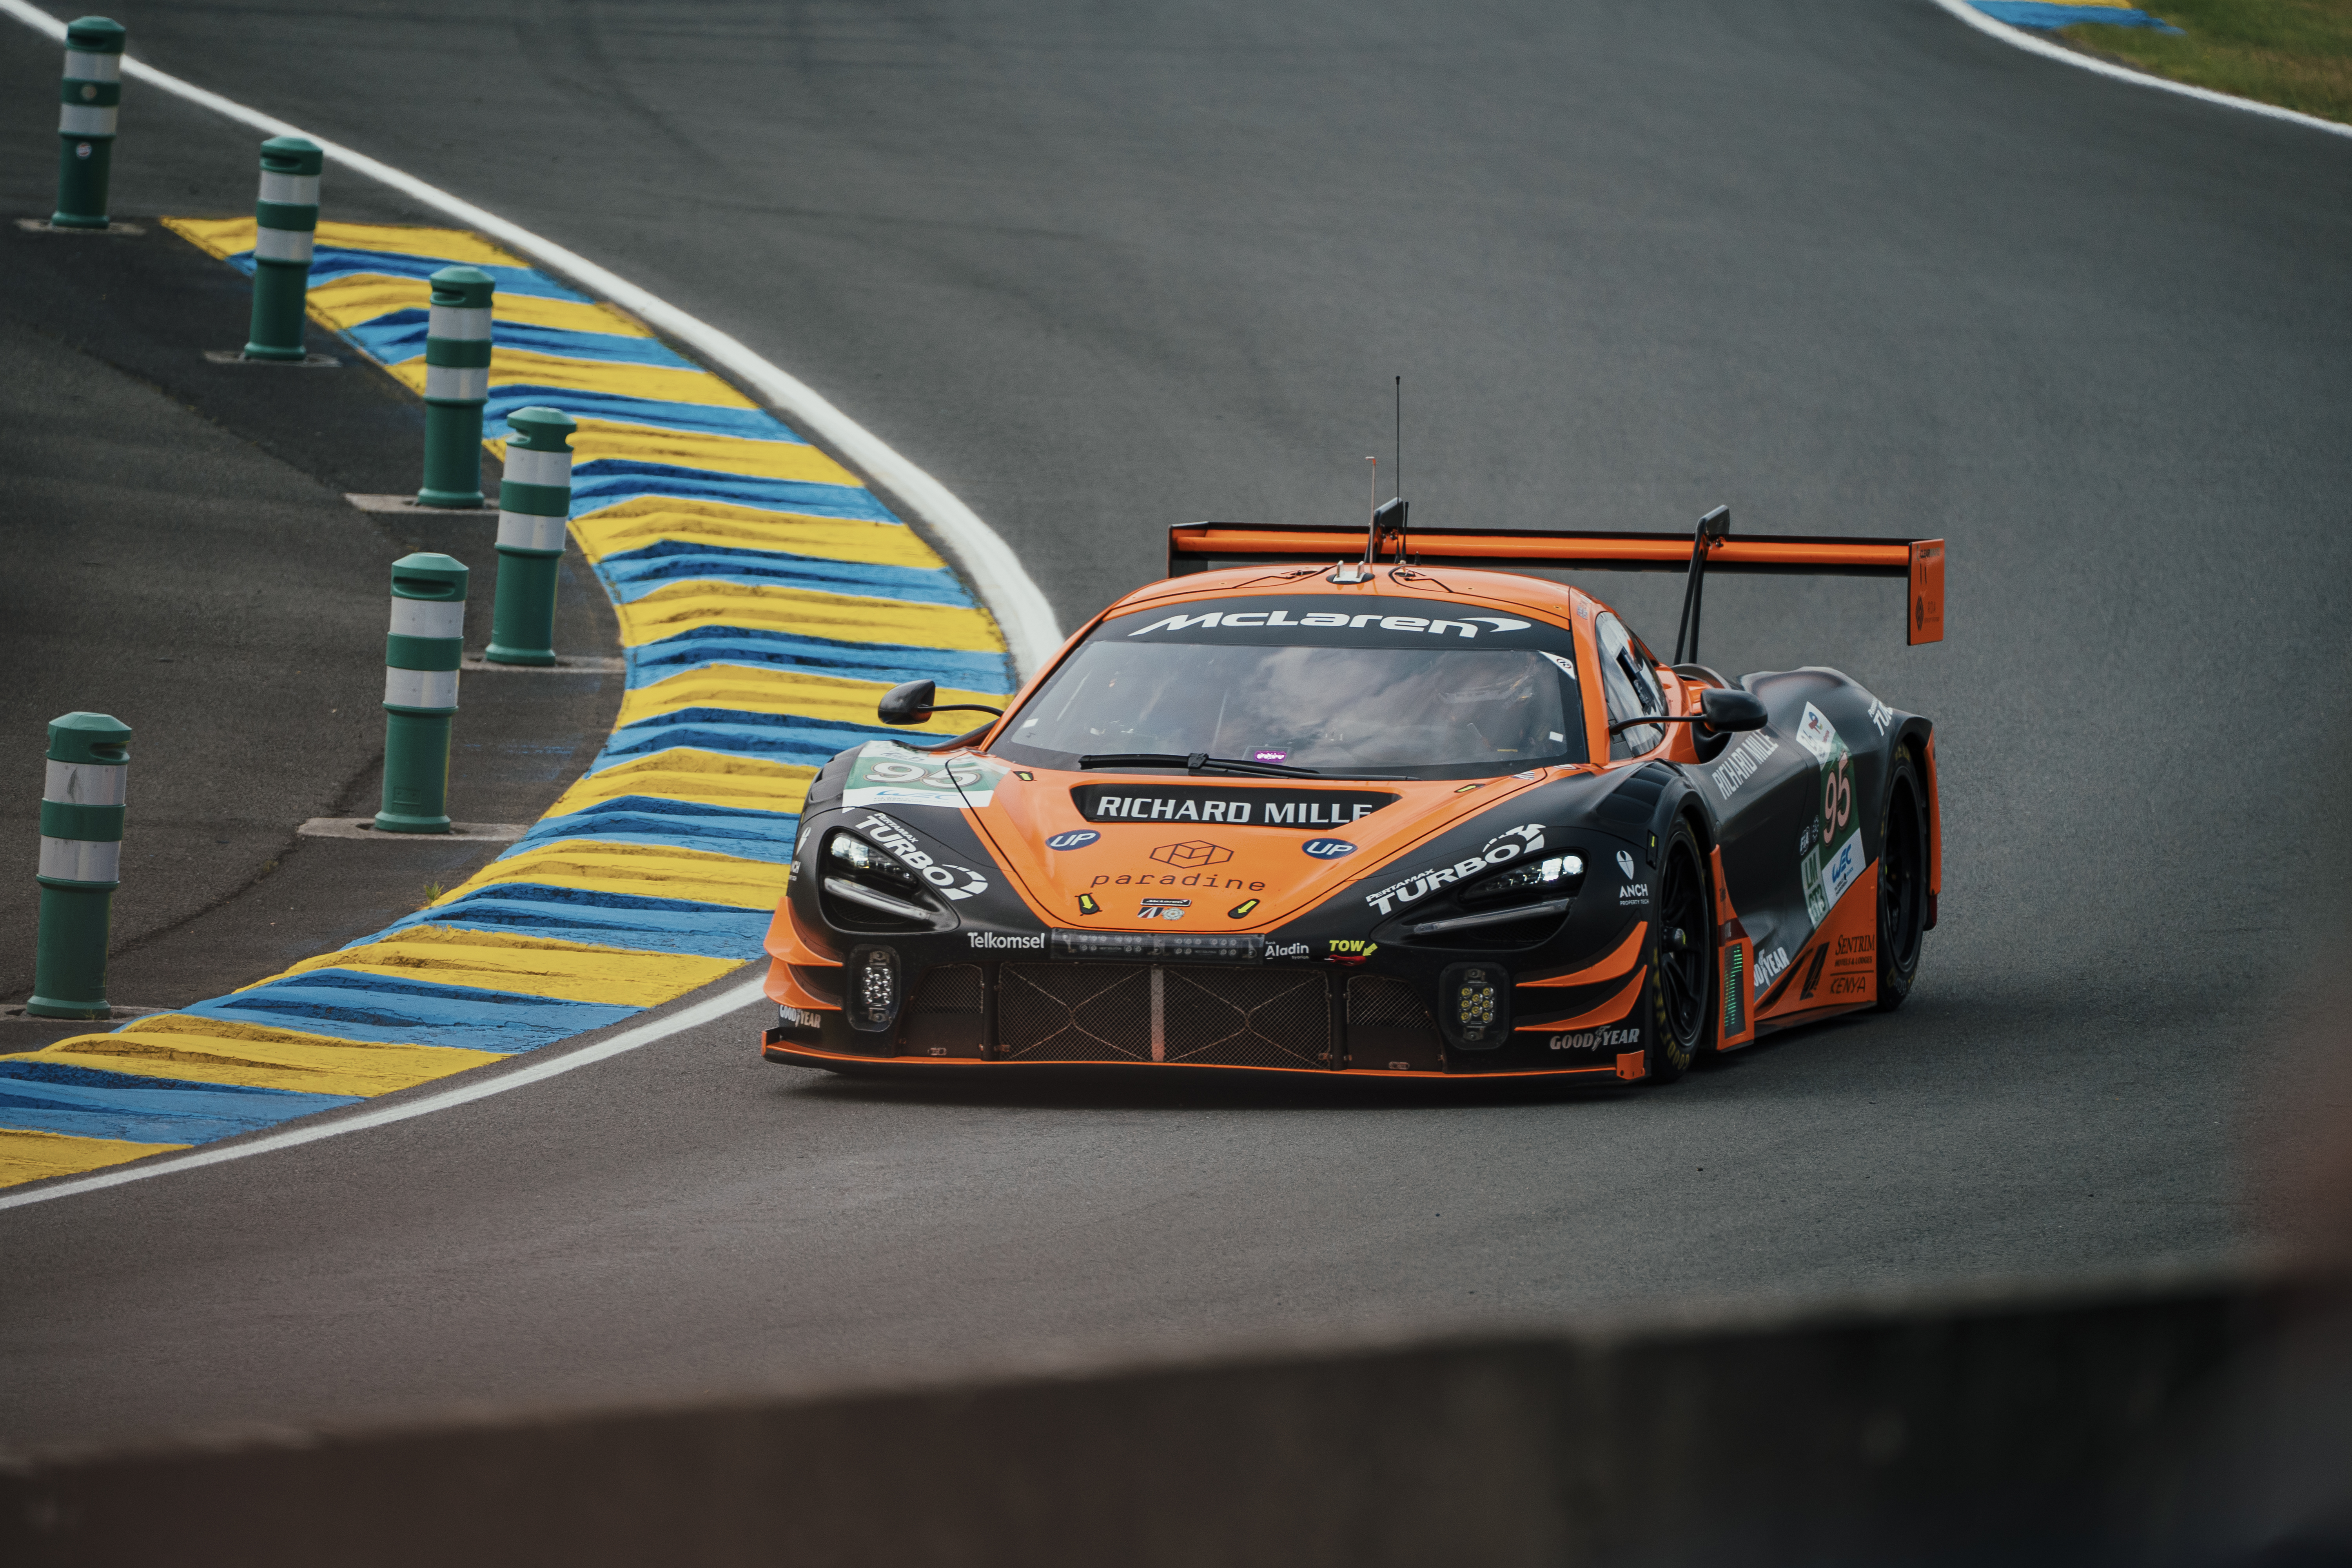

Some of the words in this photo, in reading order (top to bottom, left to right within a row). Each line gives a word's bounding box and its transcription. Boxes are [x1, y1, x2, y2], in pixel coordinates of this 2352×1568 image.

[1128, 610, 1531, 638] McLaren
[864, 762, 981, 788] 95
[1712, 747, 1757, 800] RICHARD
[1742, 729, 1779, 764] MILLE
[1097, 797, 1251, 822] RICHARD
[1823, 750, 1851, 846] 95
[874, 813, 918, 843] PERTAMAX
[1049, 832, 1096, 848] UP
[855, 815, 954, 886] TURBO
[1307, 842, 1354, 855] UP
[1805, 853, 1818, 889] LM
[1832, 844, 1851, 883] WEC
[1091, 873, 1265, 892] paradine
[1365, 869, 1435, 902] PERTAMAX
[1369, 844, 1520, 915] TURBO
[1619, 884, 1648, 898] ANCH
[967, 932, 1045, 948] Telkomsel
[1265, 943, 1309, 956] Aladin
[1329, 940, 1365, 951] TOW
[1835, 935, 1875, 955] SENTRIM
[1830, 976, 1866, 994] KENYA
[780, 1004, 821, 1028] GOODYEAR
[1550, 1025, 1640, 1051] GOODYEAR
